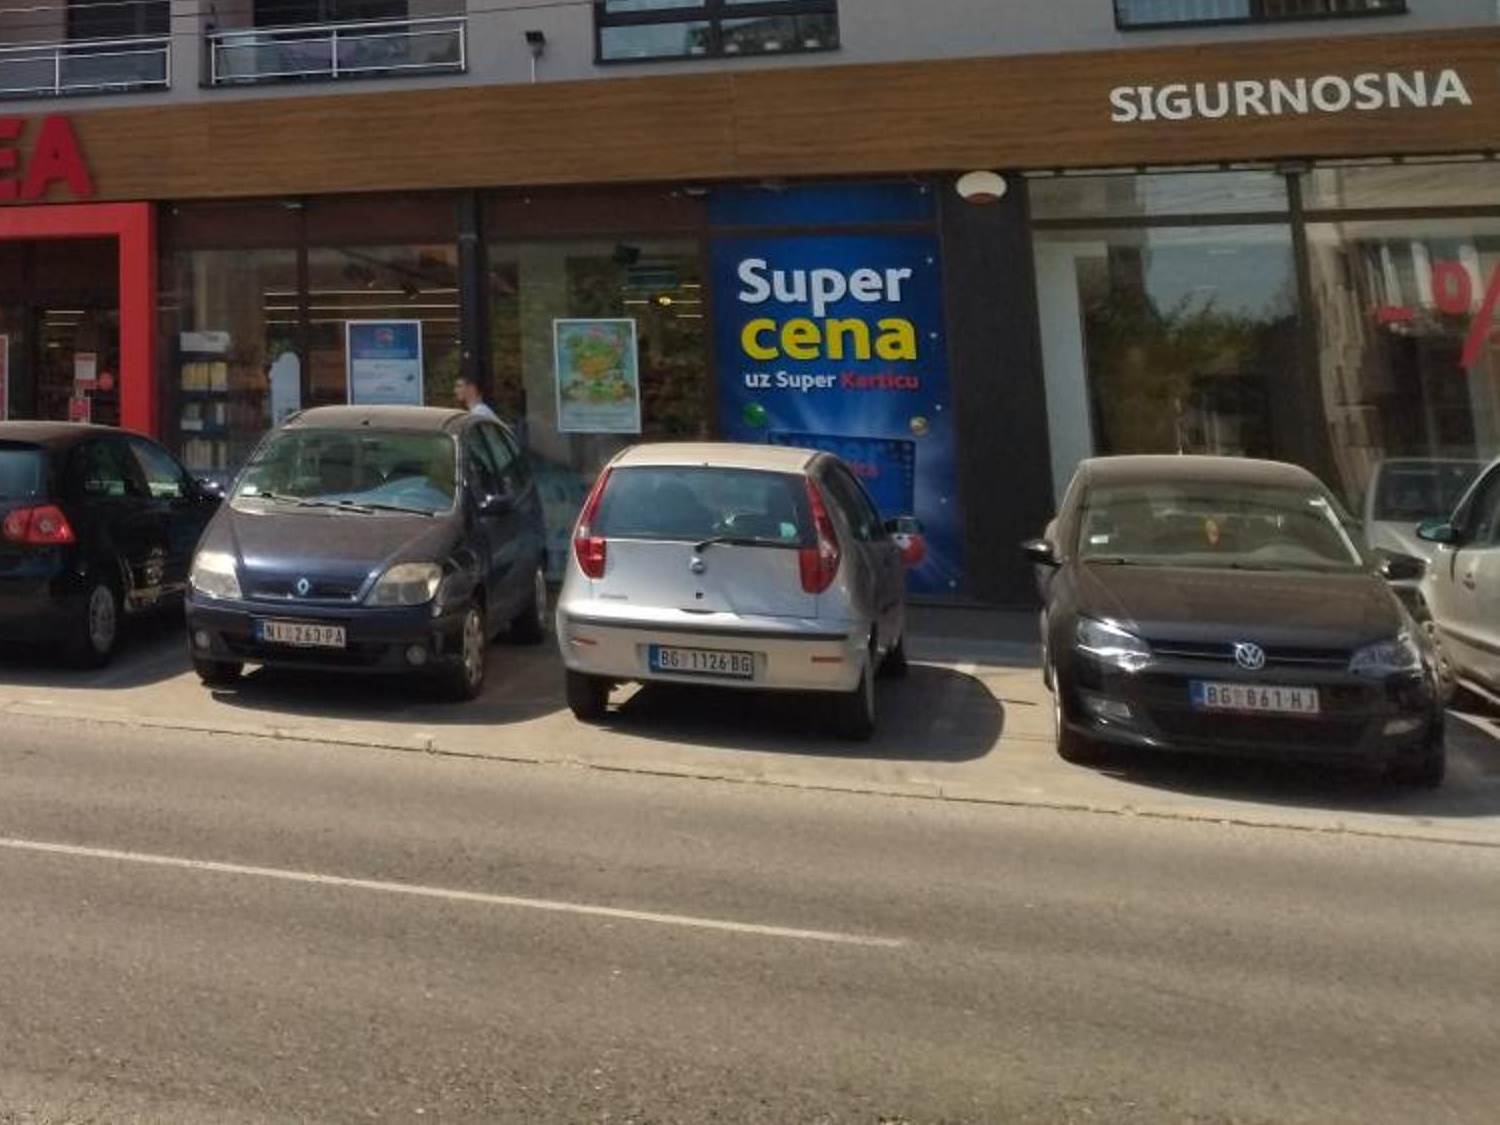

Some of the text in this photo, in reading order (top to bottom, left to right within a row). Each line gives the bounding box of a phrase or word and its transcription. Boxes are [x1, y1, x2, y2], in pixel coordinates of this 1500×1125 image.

[1109, 69, 1473, 122] SIGURNOSNA
[737, 258, 912, 318] Super
[741, 317, 917, 361] cena
[744, 373, 771, 389] uz
[776, 371, 836, 393] Super
[661, 650, 678, 667] BG
[1207, 686, 1232, 705] BG
